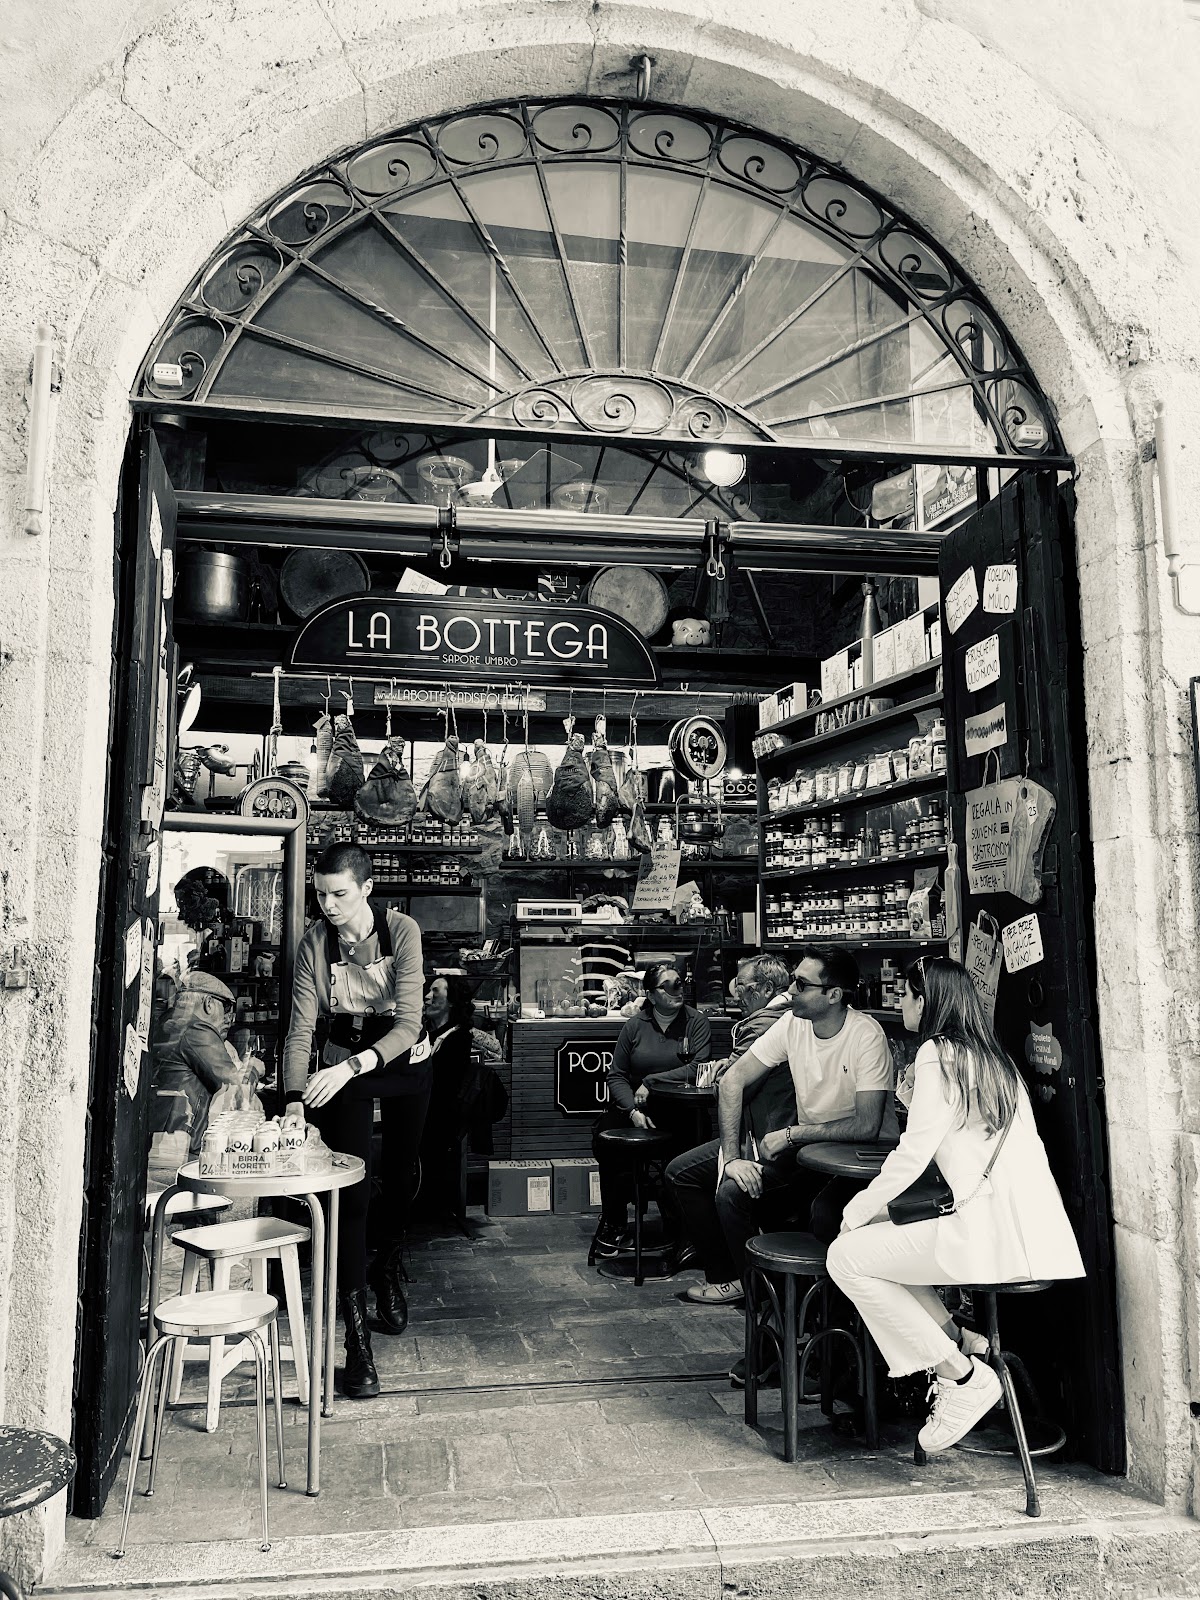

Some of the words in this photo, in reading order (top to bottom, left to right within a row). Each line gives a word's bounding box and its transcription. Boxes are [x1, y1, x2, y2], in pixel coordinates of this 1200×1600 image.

[988, 593, 1010, 611] MULO
[348, 611, 391, 650] LA
[416, 614, 608, 660] BOTTEGA
[442, 654, 480, 666] SAPORE
[484, 656, 519, 667] UMBRO
[972, 797, 1002, 821] REGALA
[1004, 799, 1013, 814] UN
[1027, 806, 1037, 817] 25
[972, 840, 1010, 862] GASTRONOM
[1031, 1032, 1051, 1043] Spoleto
[568, 1052, 614, 1072] POR
[201, 1164, 215, 1175] 24
